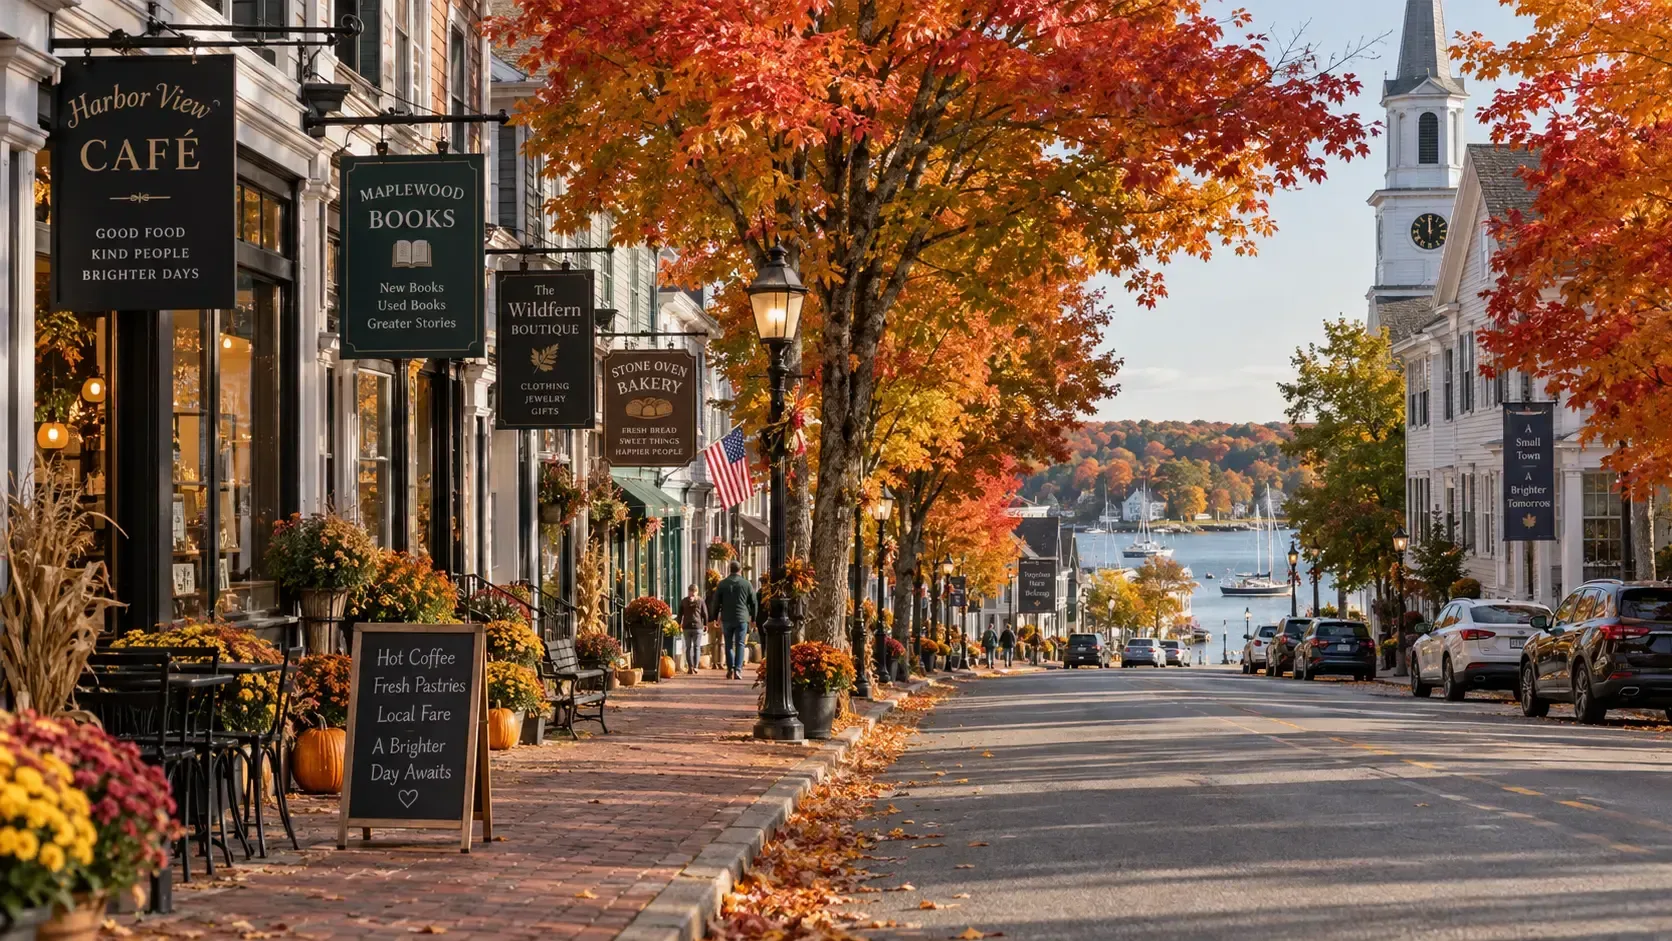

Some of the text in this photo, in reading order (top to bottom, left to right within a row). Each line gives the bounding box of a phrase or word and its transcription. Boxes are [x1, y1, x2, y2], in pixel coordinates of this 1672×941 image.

[68, 83, 211, 128] Harbor View
[81, 129, 200, 171] CAFÉ
[360, 184, 464, 202] MAPLEWOOD
[369, 209, 454, 228] BOOKS
[96, 227, 185, 238] GOOD FOOD
[92, 248, 189, 259] KIND PEOPLE
[83, 268, 198, 280] BRIGHTER DAYS
[380, 281, 444, 293] New Books
[534, 285, 554, 295] The
[378, 299, 446, 310] Used Books
[508, 301, 580, 317] Wildfern
[368, 317, 456, 329] Greater Stories
[512, 324, 579, 336] BOUTIQUE
[612, 361, 688, 377] STONE OVEN
[617, 377, 683, 395] BAKERY
[525, 395, 565, 404] JEWELRY
[1525, 424, 1532, 433] A
[619, 437, 680, 445] SWEET THINGS
[1516, 438, 1540, 446] Small
[615, 448, 650, 456] HAPPIER
[1517, 451, 1540, 459] Town
[1525, 472, 1532, 480] A
[1511, 485, 1546, 496] Brighter
[378, 648, 455, 668] Hot Coffee
[374, 676, 465, 694] Fresh Pastries
[377, 705, 450, 722] Local Fare
[372, 737, 446, 758] A Brighter
[371, 763, 451, 785] Day Awaits
